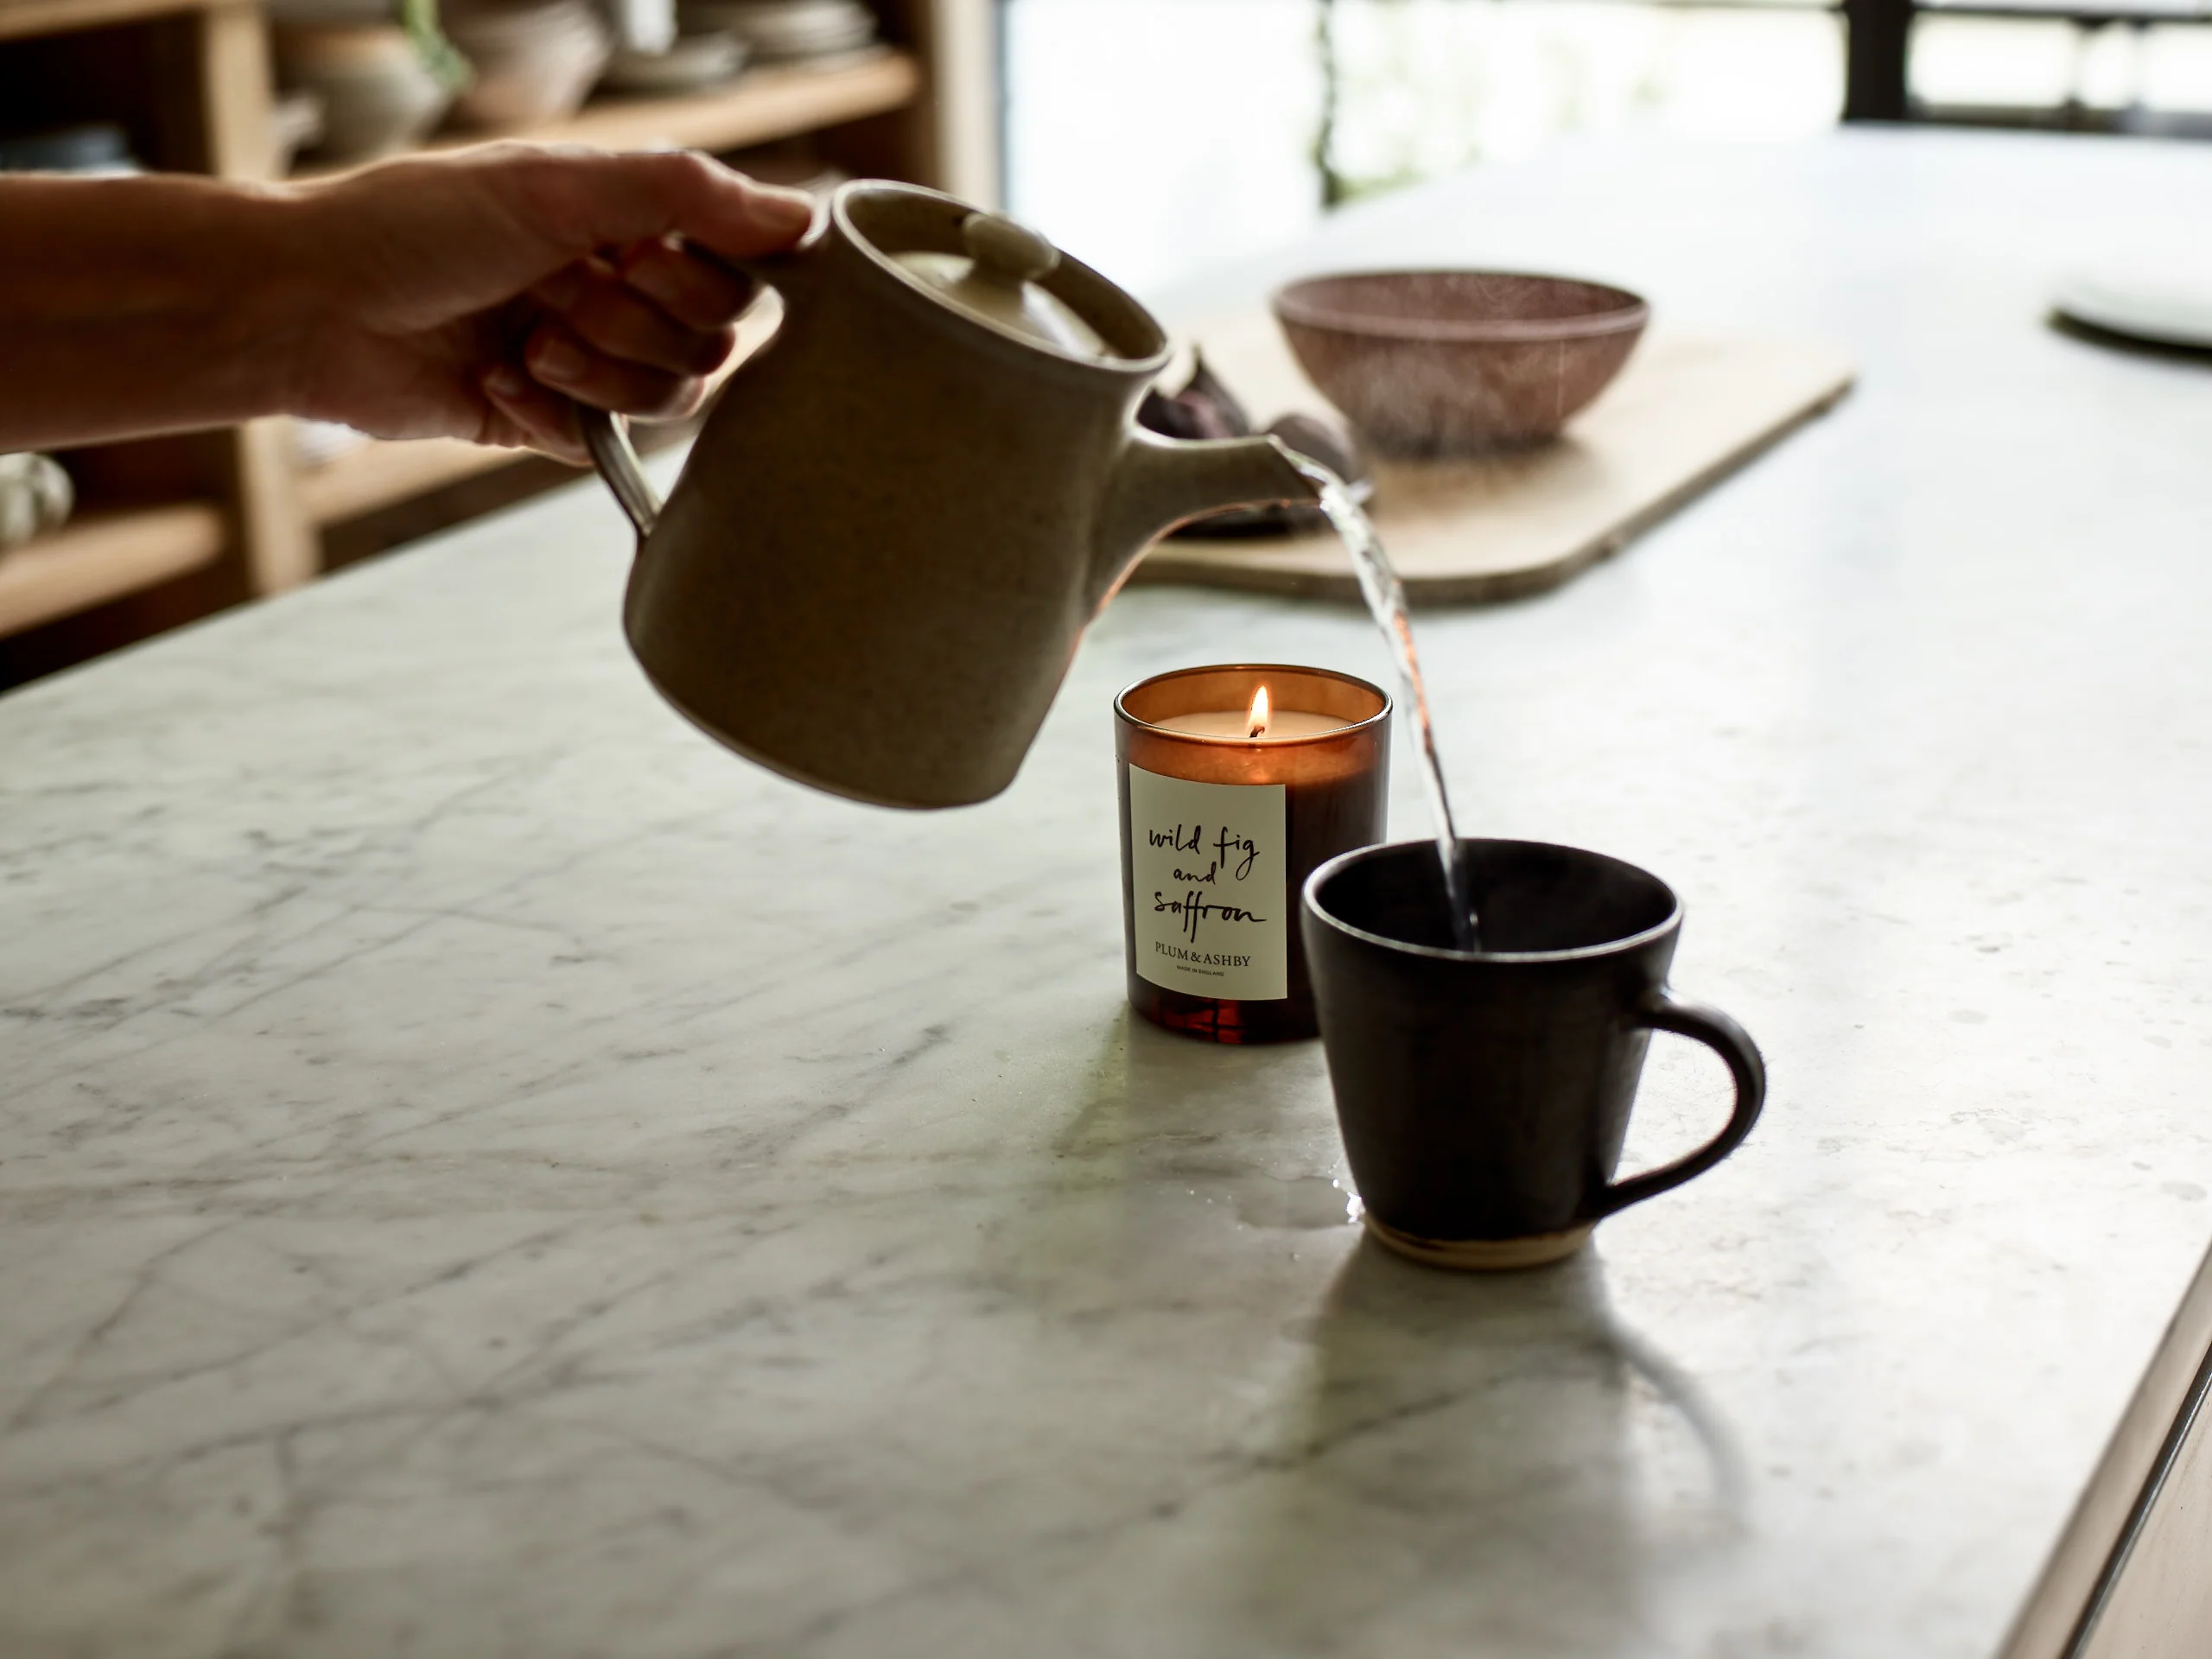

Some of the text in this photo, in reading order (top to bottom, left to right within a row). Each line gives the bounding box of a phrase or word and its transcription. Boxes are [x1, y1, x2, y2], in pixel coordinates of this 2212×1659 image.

[1149, 823, 1260, 880] wild fig
[1173, 861, 1217, 885] and
